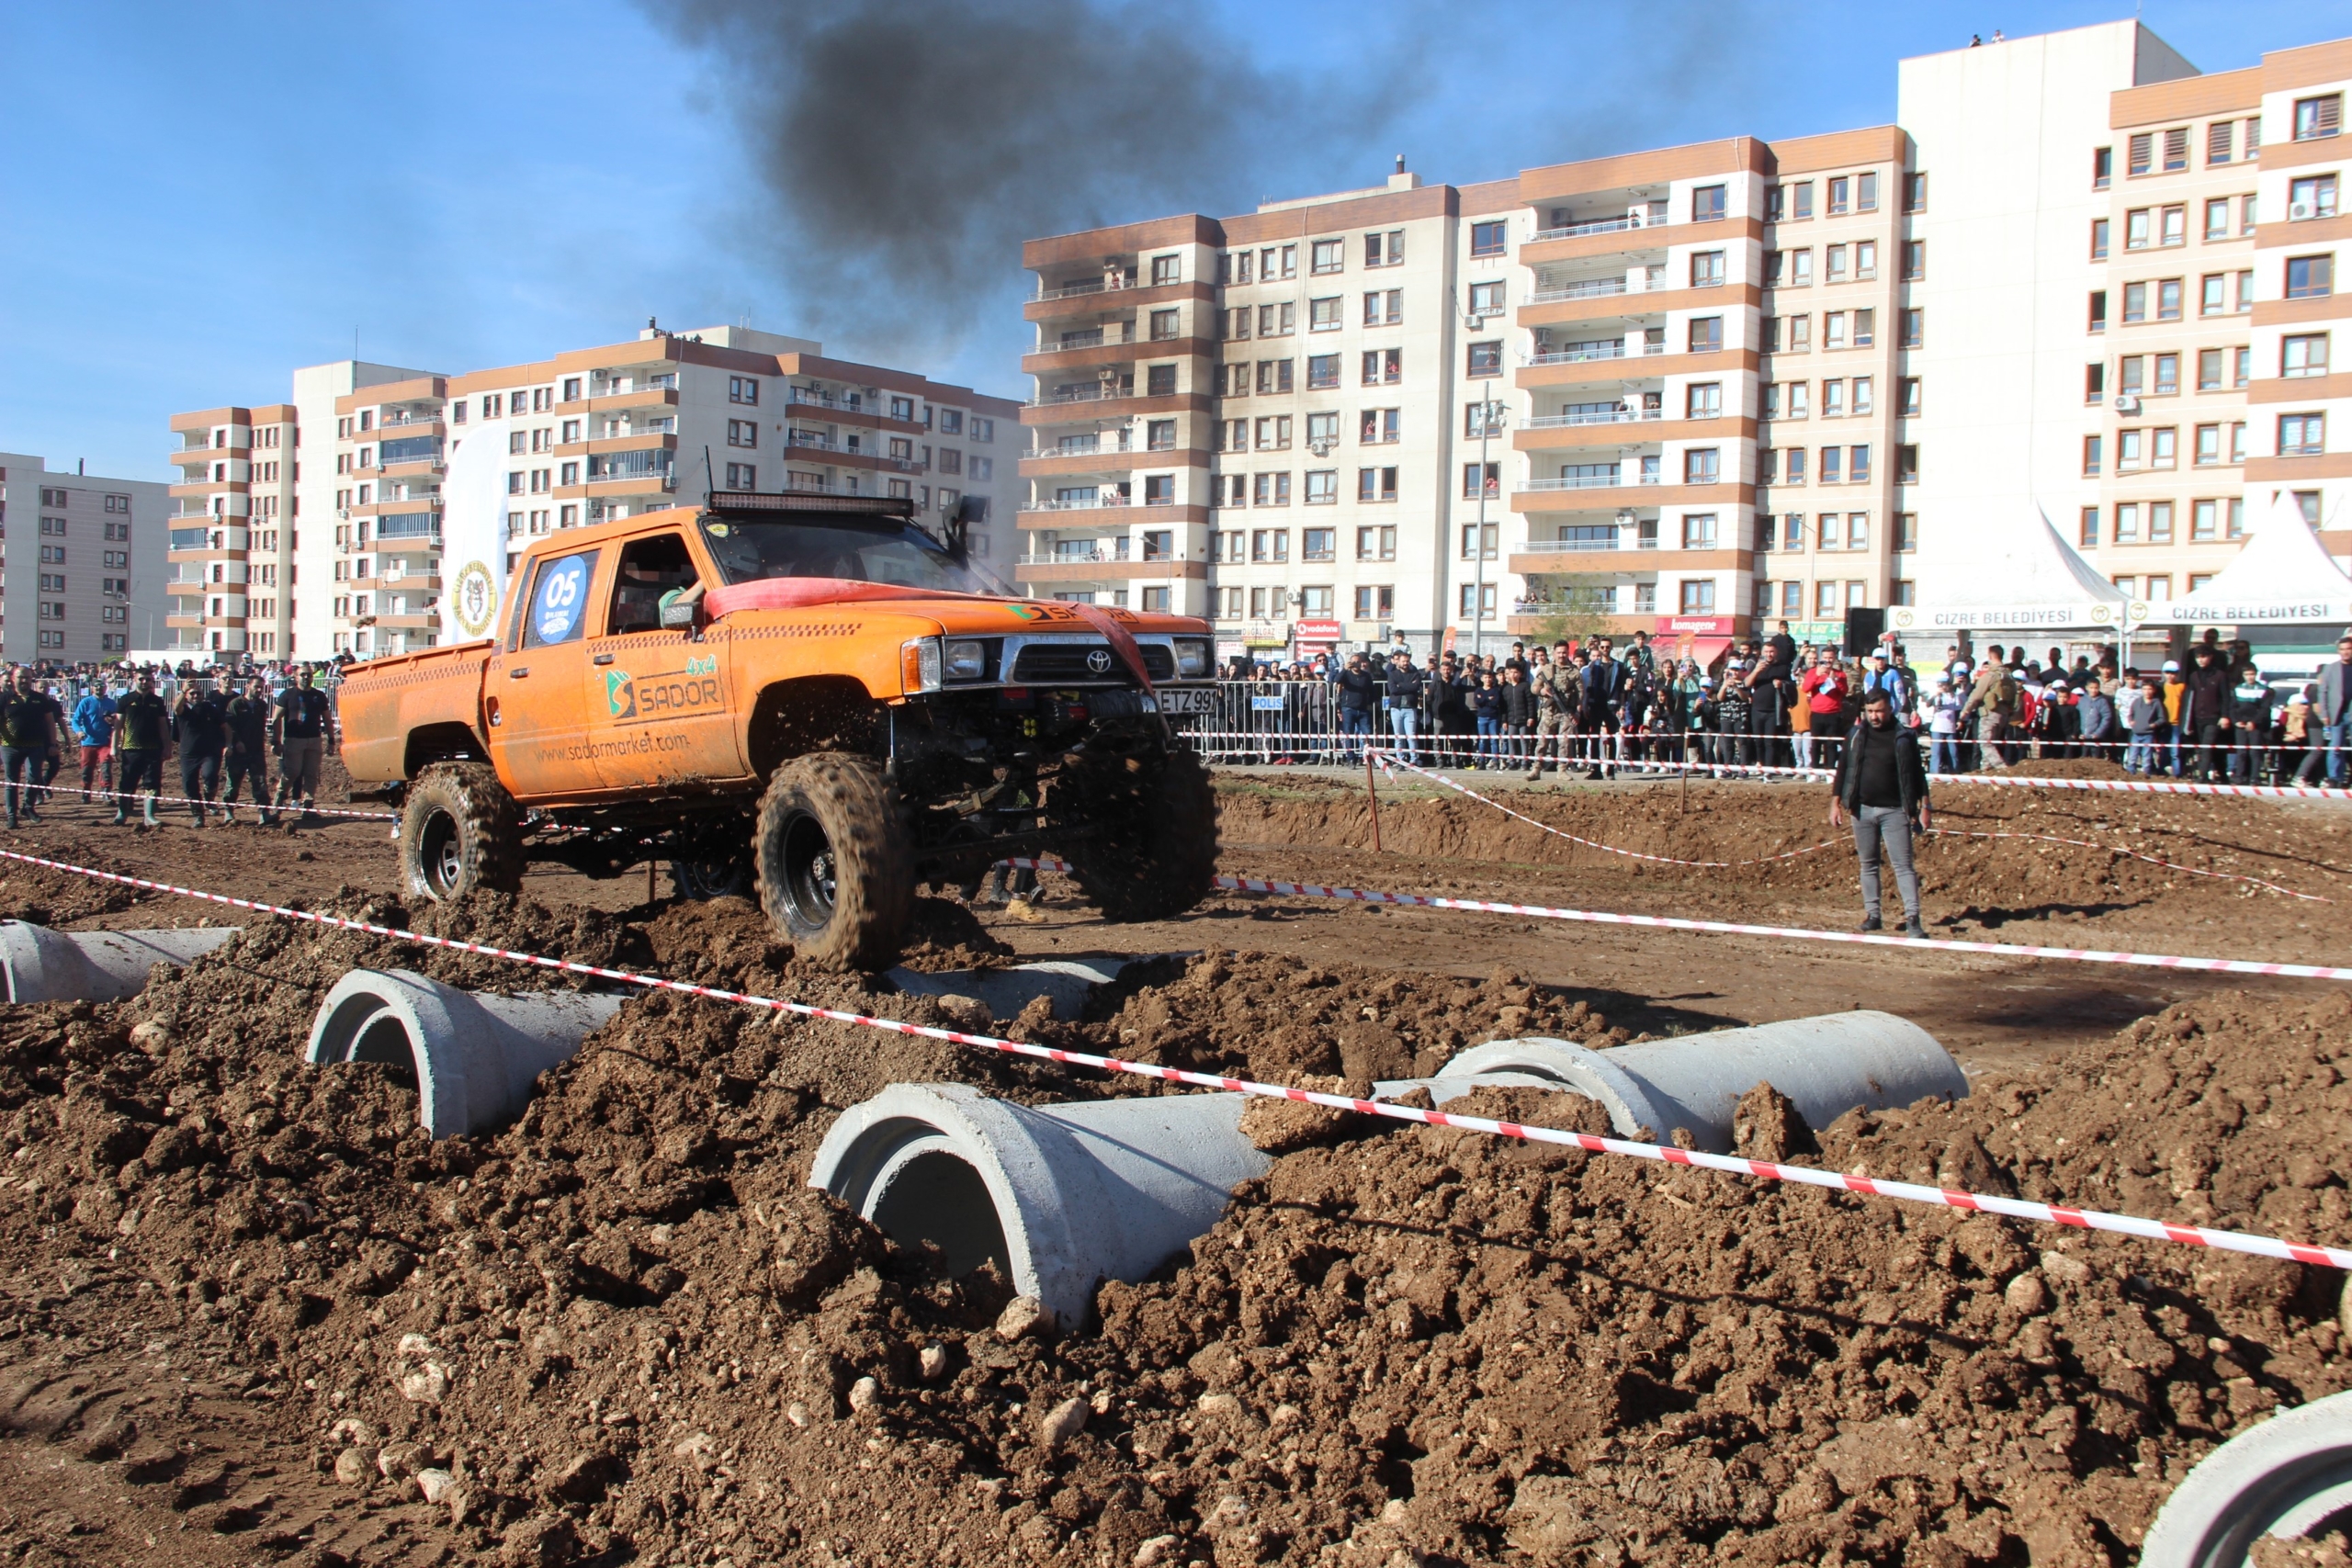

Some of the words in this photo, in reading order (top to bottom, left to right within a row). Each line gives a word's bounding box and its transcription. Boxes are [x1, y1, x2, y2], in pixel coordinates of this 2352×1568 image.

[546, 570, 580, 608] 05
[1670, 618, 1717, 634] komagene
[1935, 610, 1977, 625] CİZRE
[1983, 606, 2074, 624] BELEDİYESİ
[1306, 625, 1339, 633] vodafone
[686, 654, 716, 677] 4x4
[639, 679, 719, 713] SADOR
[1160, 690, 1193, 711] ETZ
[1193, 690, 1217, 711] 991
[534, 732, 691, 763] www.sadormarket.com
